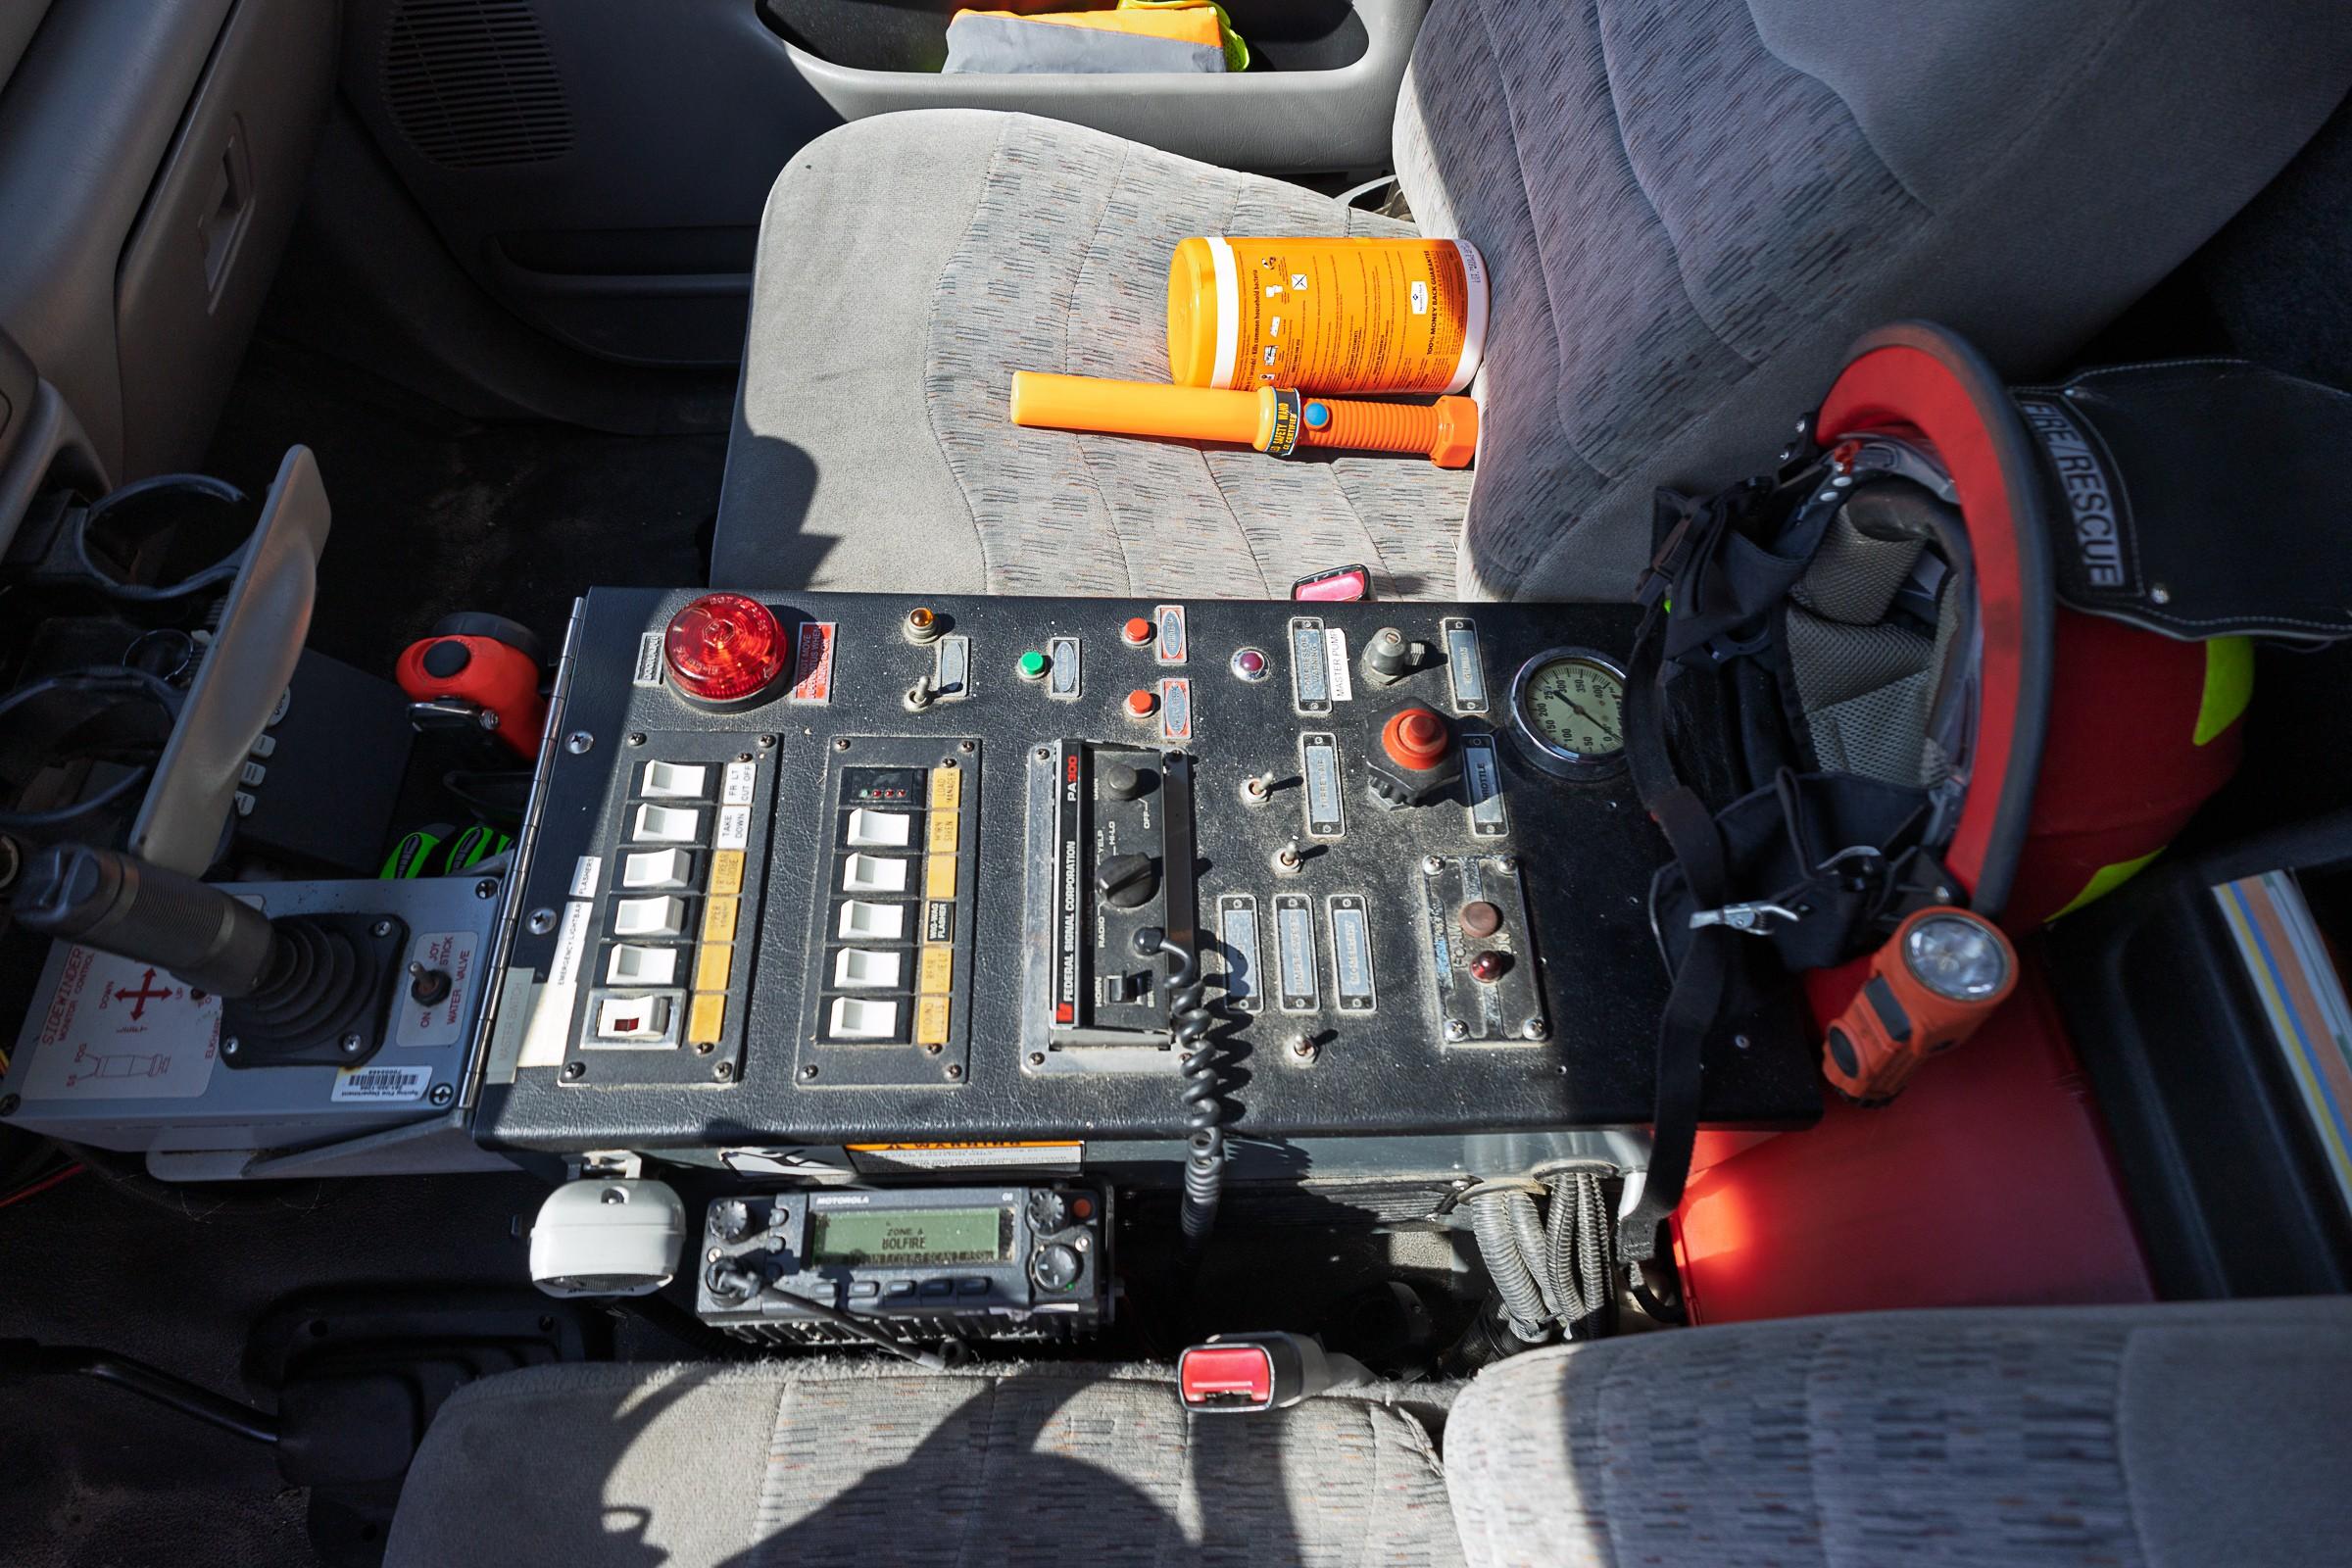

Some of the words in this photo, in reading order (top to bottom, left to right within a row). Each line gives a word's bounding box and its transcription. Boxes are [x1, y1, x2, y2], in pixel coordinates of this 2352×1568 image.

[1424, 251, 1437, 285] GUARANTEE
[1427, 334, 1436, 355] 100%
[1277, 402, 1290, 421] WAND
[1273, 423, 1287, 446] SAFETY
[2022, 403, 2121, 583] FIRE/RESCUE
[802, 634, 812, 658] MOVE
[1330, 630, 1340, 657] PUMP
[1300, 636, 1311, 692] COMPRESSOR
[1311, 644, 1320, 686] WARNING
[1333, 659, 1345, 697] MASTER
[1556, 680, 1568, 694] 300
[1574, 678, 1586, 693] 350
[1592, 684, 1604, 699] 400
[1537, 703, 1549, 716] 200
[1545, 719, 1556, 733] 150
[1561, 728, 1573, 742] 100
[1583, 736, 1594, 747] 50
[731, 769, 739, 780] LT
[743, 764, 753, 781] OFF
[1067, 756, 1078, 802] PA300
[728, 785, 738, 797] FR
[741, 786, 750, 802] CUT
[721, 814, 732, 837] TAKE
[734, 812, 745, 839] DOWN
[1065, 840, 1076, 911] CORPORATION
[929, 903, 939, 940] WIG-WAG
[938, 904, 948, 939] FLASHER
[1064, 912, 1075, 953] SIGNAL
[429, 943, 440, 961] JOY
[440, 936, 454, 965] STICK
[558, 941, 573, 986] EMERGENCY
[566, 903, 582, 940] LIGHTBAR
[447, 989, 462, 1025] WATER
[456, 950, 470, 982] VALVE
[1063, 954, 1074, 1002] FEDERAL
[42, 948, 81, 1046] SIDEWINDER
[58, 1000, 78, 1041] MONITOR
[74, 953, 95, 994] CONTROL
[99, 981, 115, 1009] DOWN
[175, 987, 184, 1000] UP
[420, 1011, 431, 1028] ON
[498, 1019, 514, 1061] MASTER
[508, 982, 523, 1019] SWITCH
[816, 1196, 869, 1205] MOTOROLA
[887, 1228, 912, 1237] ZONE
